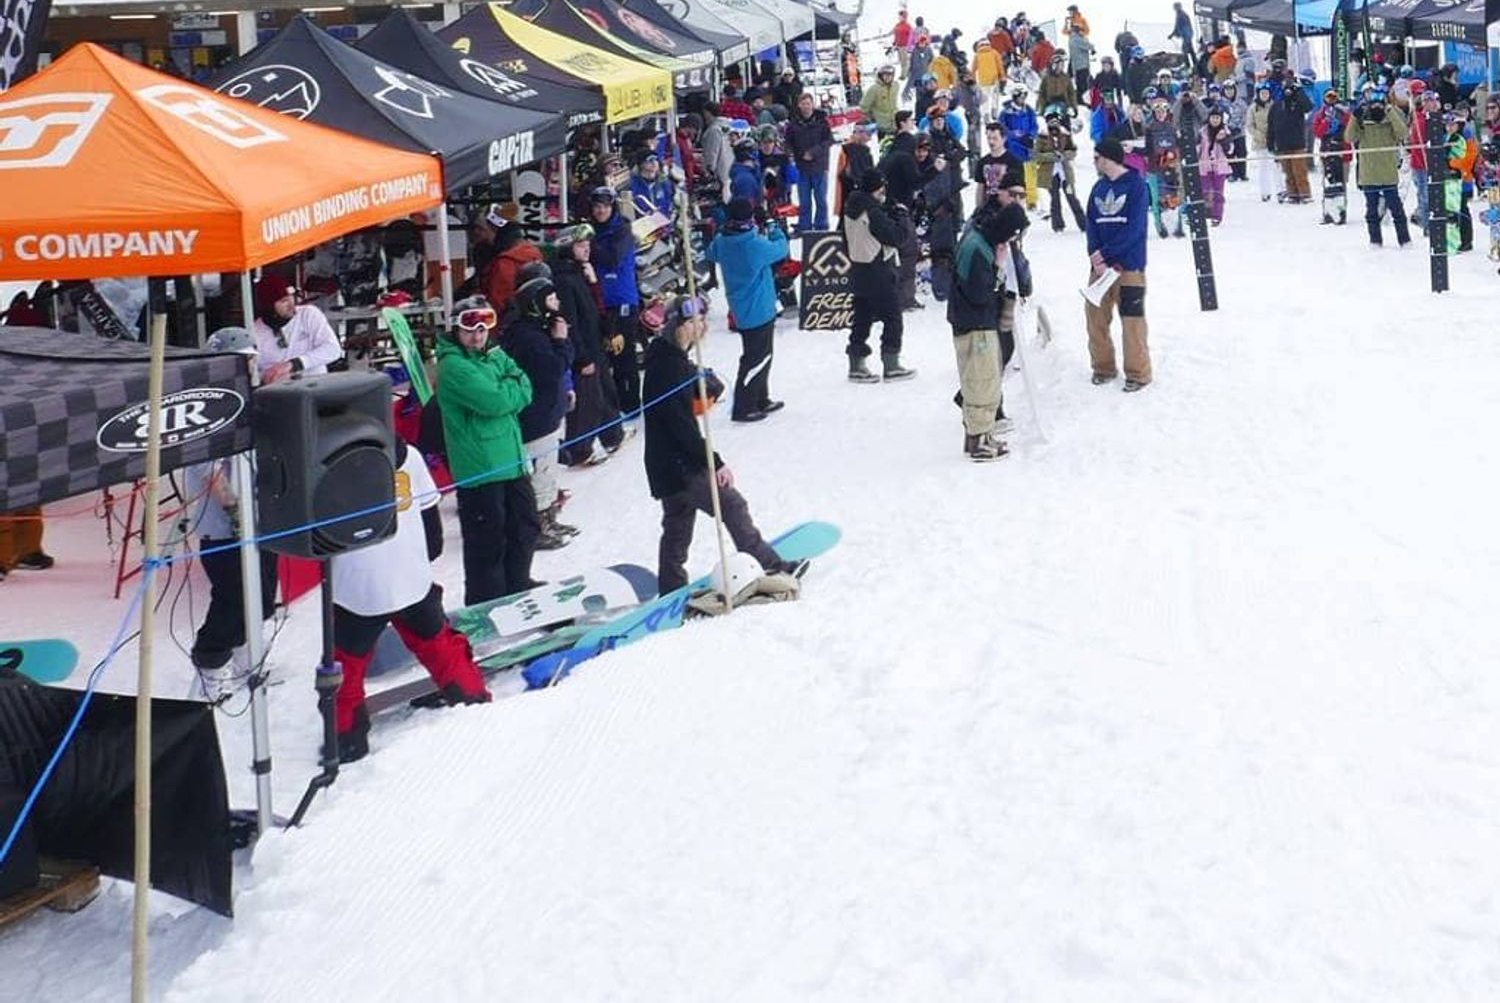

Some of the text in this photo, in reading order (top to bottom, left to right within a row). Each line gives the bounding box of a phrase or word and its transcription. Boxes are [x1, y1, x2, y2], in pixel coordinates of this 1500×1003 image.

[1431, 22, 1466, 39] ELECTRIC
[262, 172, 428, 243] UNION BINDING COMPANY
[14, 229, 200, 261] COMPANY
[806, 293, 854, 311] FREE
